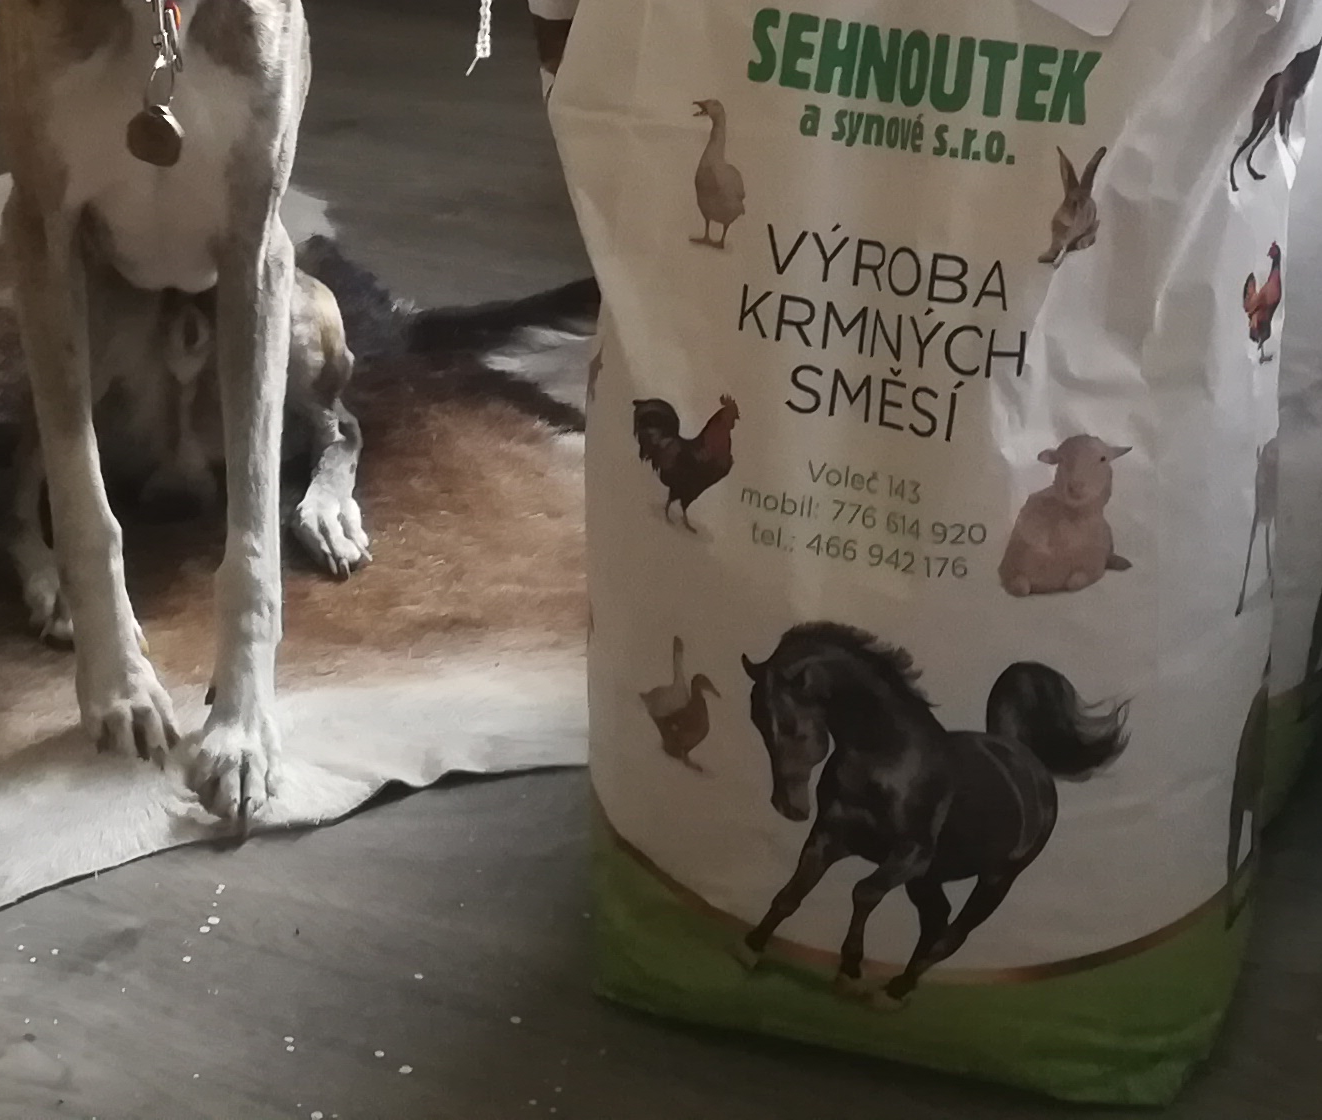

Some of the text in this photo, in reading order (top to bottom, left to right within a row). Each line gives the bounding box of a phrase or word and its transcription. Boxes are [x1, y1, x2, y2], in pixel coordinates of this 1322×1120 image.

[747, 7, 1103, 126] SEHNOUTEK
[799, 102, 1017, 166] a synové s.r.o.
[767, 222, 1009, 313] VÝROBA
[737, 283, 1028, 380] KRMNÝCH
[785, 364, 965, 443] SMĚSÍ
[808, 459, 922, 505] Voleč 143
[806, 533, 858, 562] 466
[868, 544, 916, 575] 942
[924, 556, 968, 579] 176
[832, 499, 877, 529] 776
[886, 511, 922, 541] 614
[931, 521, 987, 546] 920
